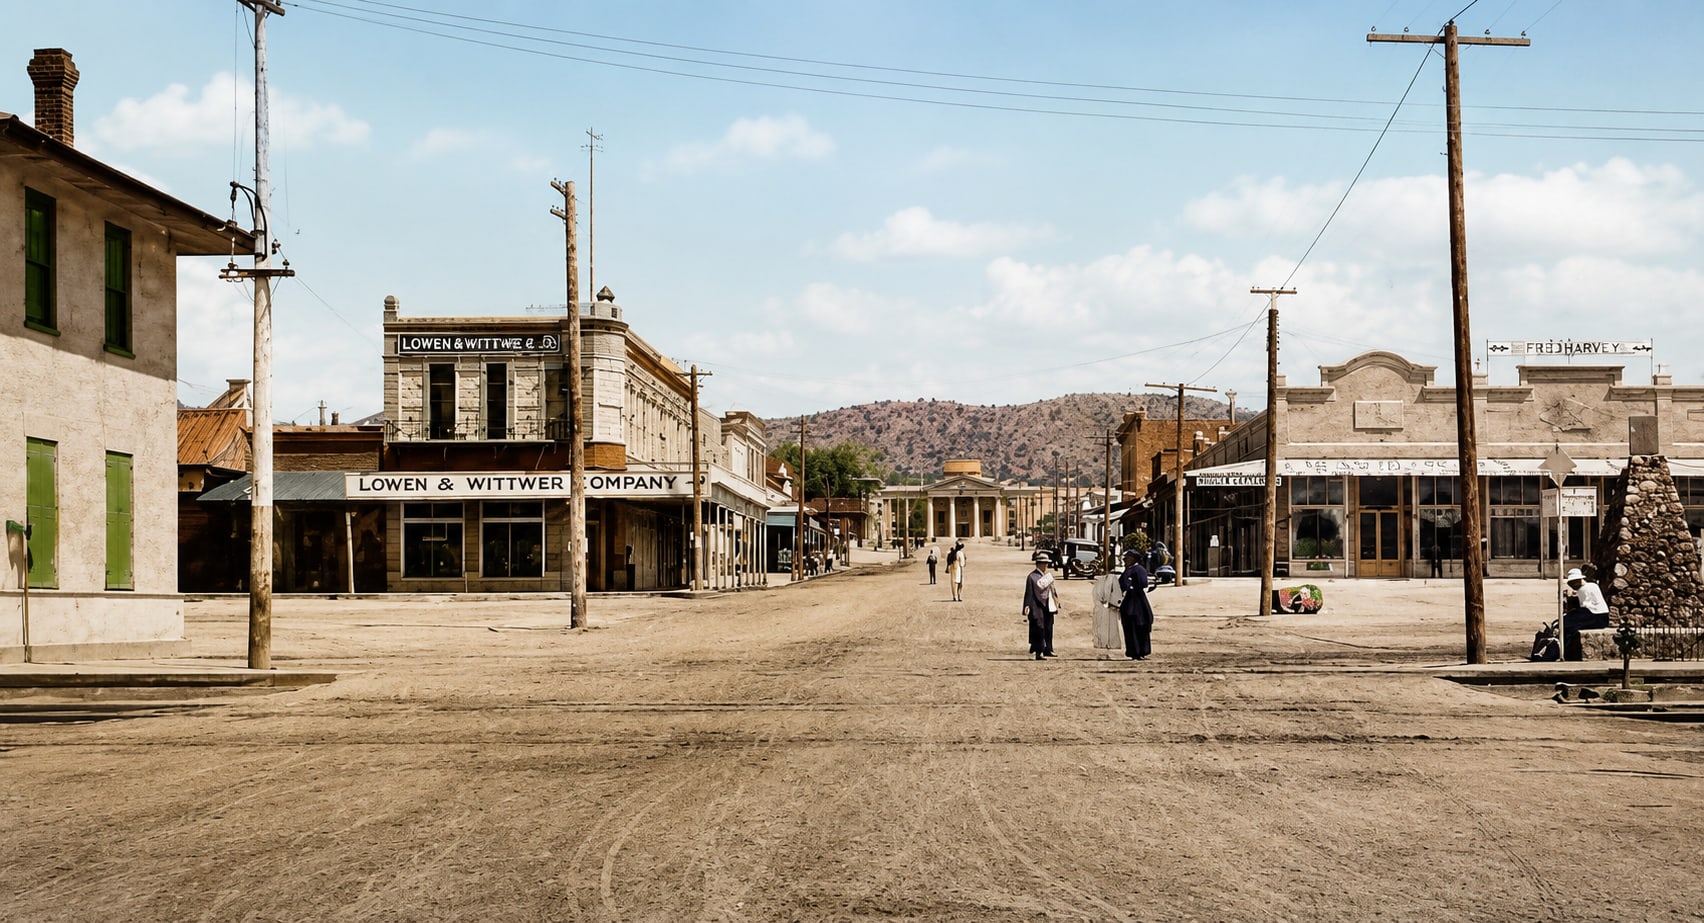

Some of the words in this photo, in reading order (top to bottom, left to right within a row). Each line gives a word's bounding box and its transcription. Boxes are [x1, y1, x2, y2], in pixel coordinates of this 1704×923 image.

[402, 337, 451, 350] LOWEN
[454, 337, 463, 350] &
[1564, 342, 1620, 355] HARVEY
[359, 478, 427, 491] LOWEN
[437, 478, 454, 491] &
[466, 477, 564, 490] WITTWER
[584, 476, 677, 490] OMPANY
